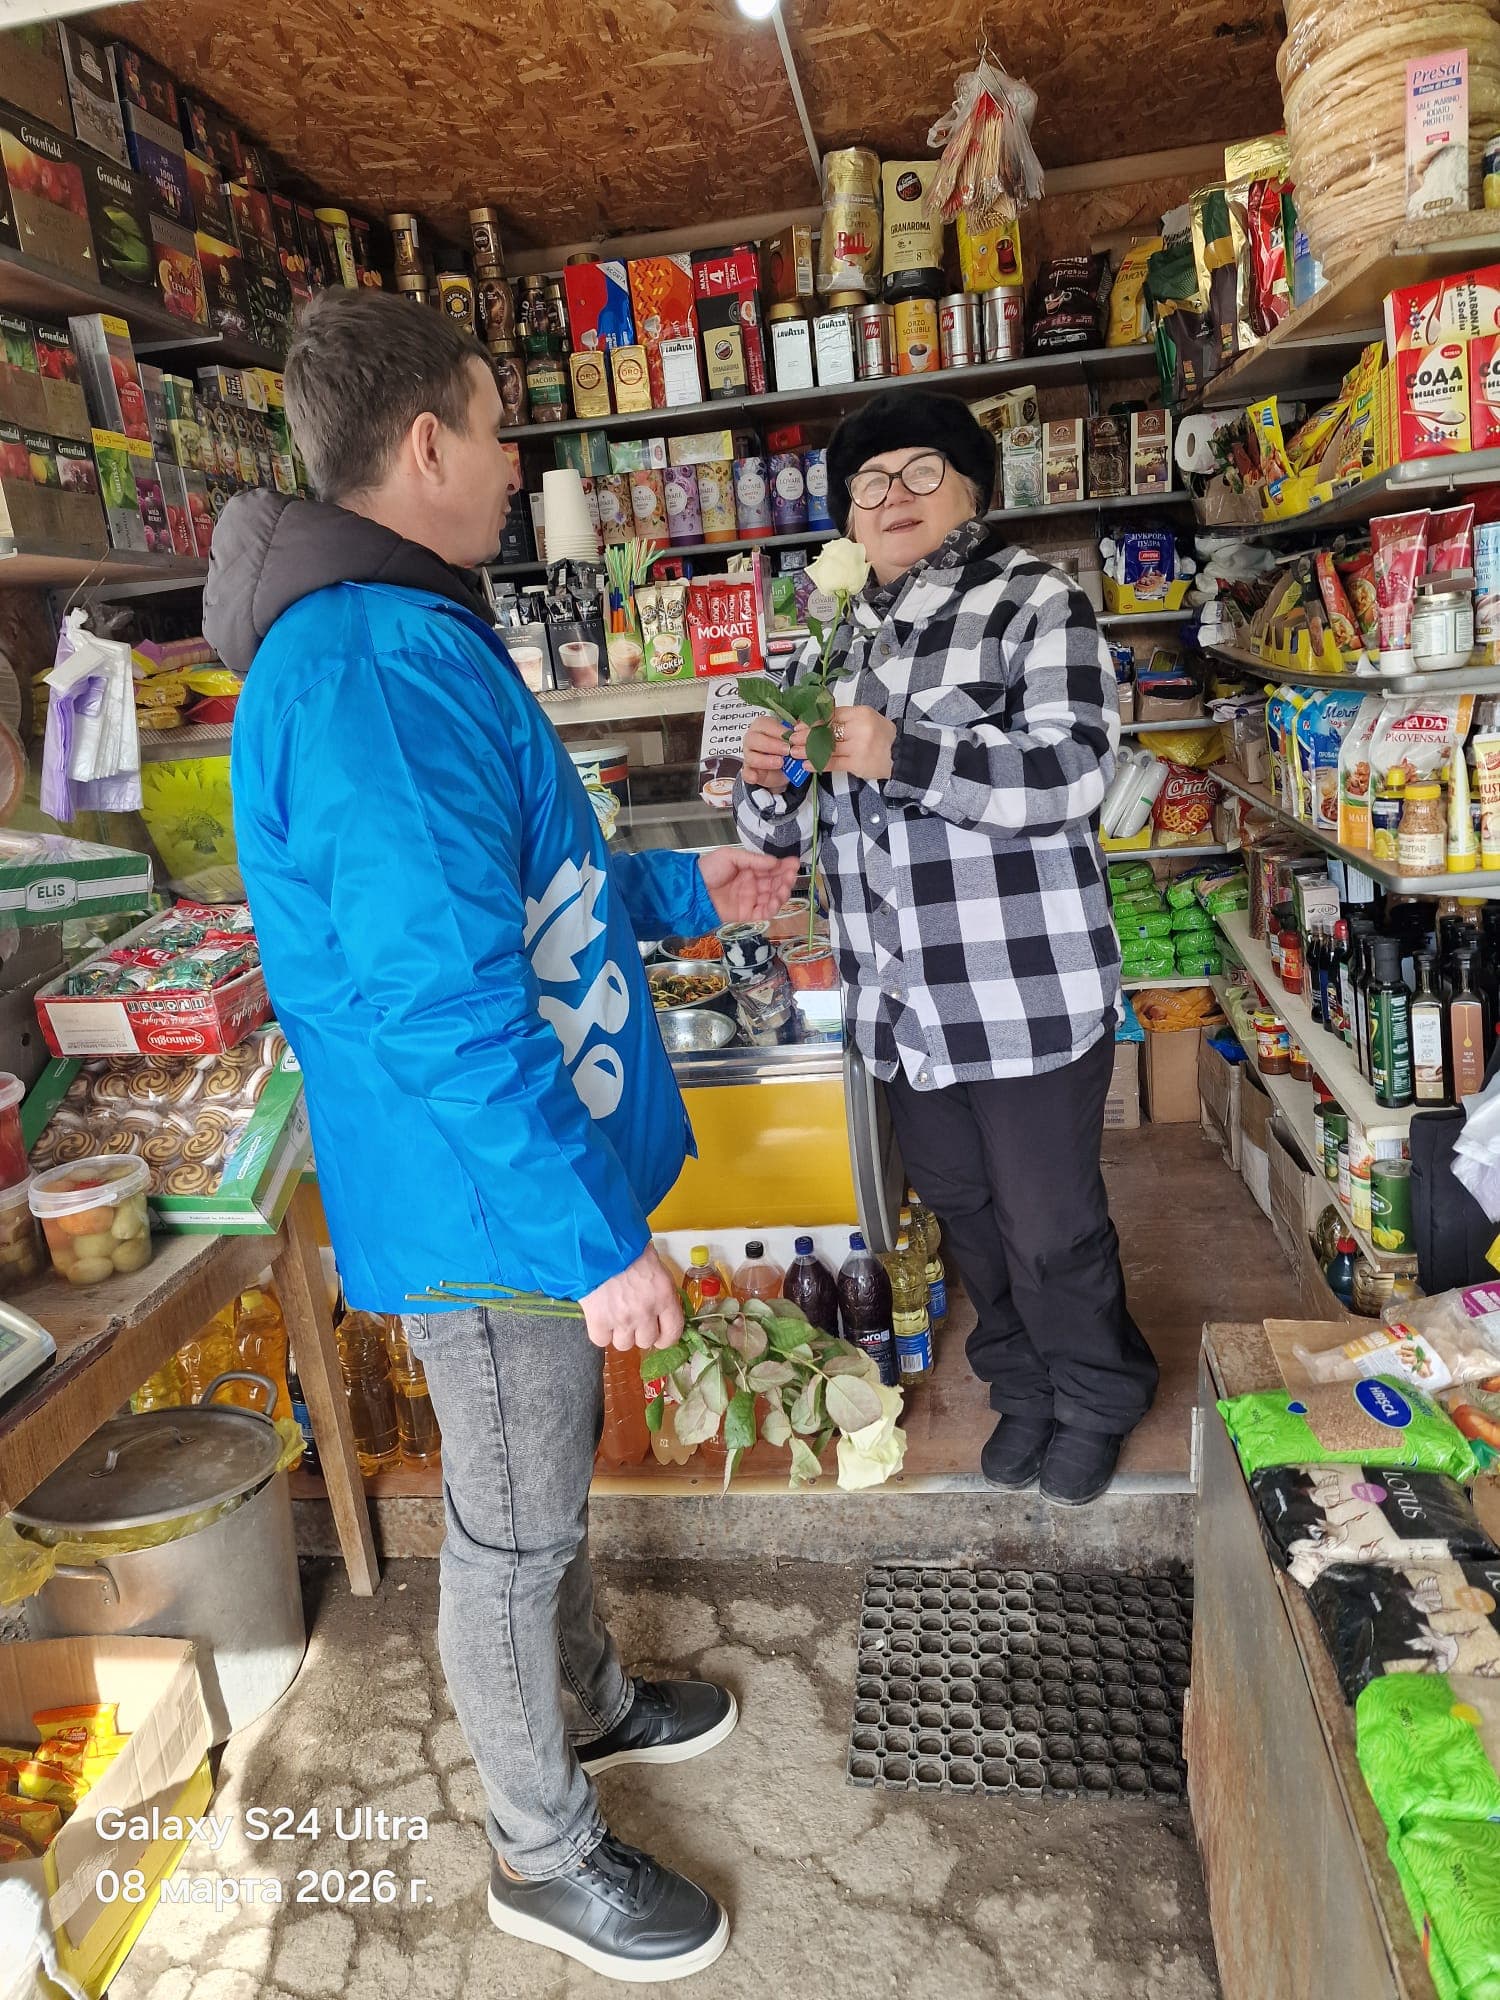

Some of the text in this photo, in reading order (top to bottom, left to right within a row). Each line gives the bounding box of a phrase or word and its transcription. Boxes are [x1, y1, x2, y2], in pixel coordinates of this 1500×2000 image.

[1413, 61, 1461, 85] PreSal
[1416, 95, 1460, 112] SALE MARINO
[1426, 106, 1450, 117] IODATO
[1422, 115, 1454, 128] PROTETTO
[20, 126, 63, 159] Greenfield
[97, 165, 133, 195] Greenfield
[155, 176, 182, 197] NIGHTS
[890, 221, 931, 235] GRANAROMA
[916, 252, 922, 261] 8
[605, 265, 627, 286] SCORTA
[709, 269, 724, 284] 4
[478, 292, 486, 320] GOLD
[1005, 305, 1018, 317] illy
[1456, 286, 1467, 331] de Sodiu
[818, 319, 847, 330] LAVAZZA
[907, 320, 926, 328] ORZO
[942, 314, 954, 328] illy
[38, 327, 69, 345] Greenfield
[777, 328, 805, 339] LAVAZZA
[865, 324, 880, 336] illy
[902, 327, 931, 336] SOLUBILE
[665, 343, 693, 353] LAVAZZA
[579, 372, 598, 382] ORO
[622, 367, 640, 377] ORO
[1405, 365, 1463, 389] СОДА
[531, 375, 558, 385] JACOBS
[1407, 385, 1463, 400] пищевая
[58, 443, 86, 458] Greenfield
[697, 621, 754, 640] MOKATE
[656, 655, 685, 673] ЖОКЕЙ
[712, 710, 767, 722] Cappucino
[709, 736, 742, 744] Cafea
[1385, 733, 1449, 744] PROVENSAL
[708, 746, 744, 756] Ciocol
[1382, 1471, 1427, 1520] LOTUS
